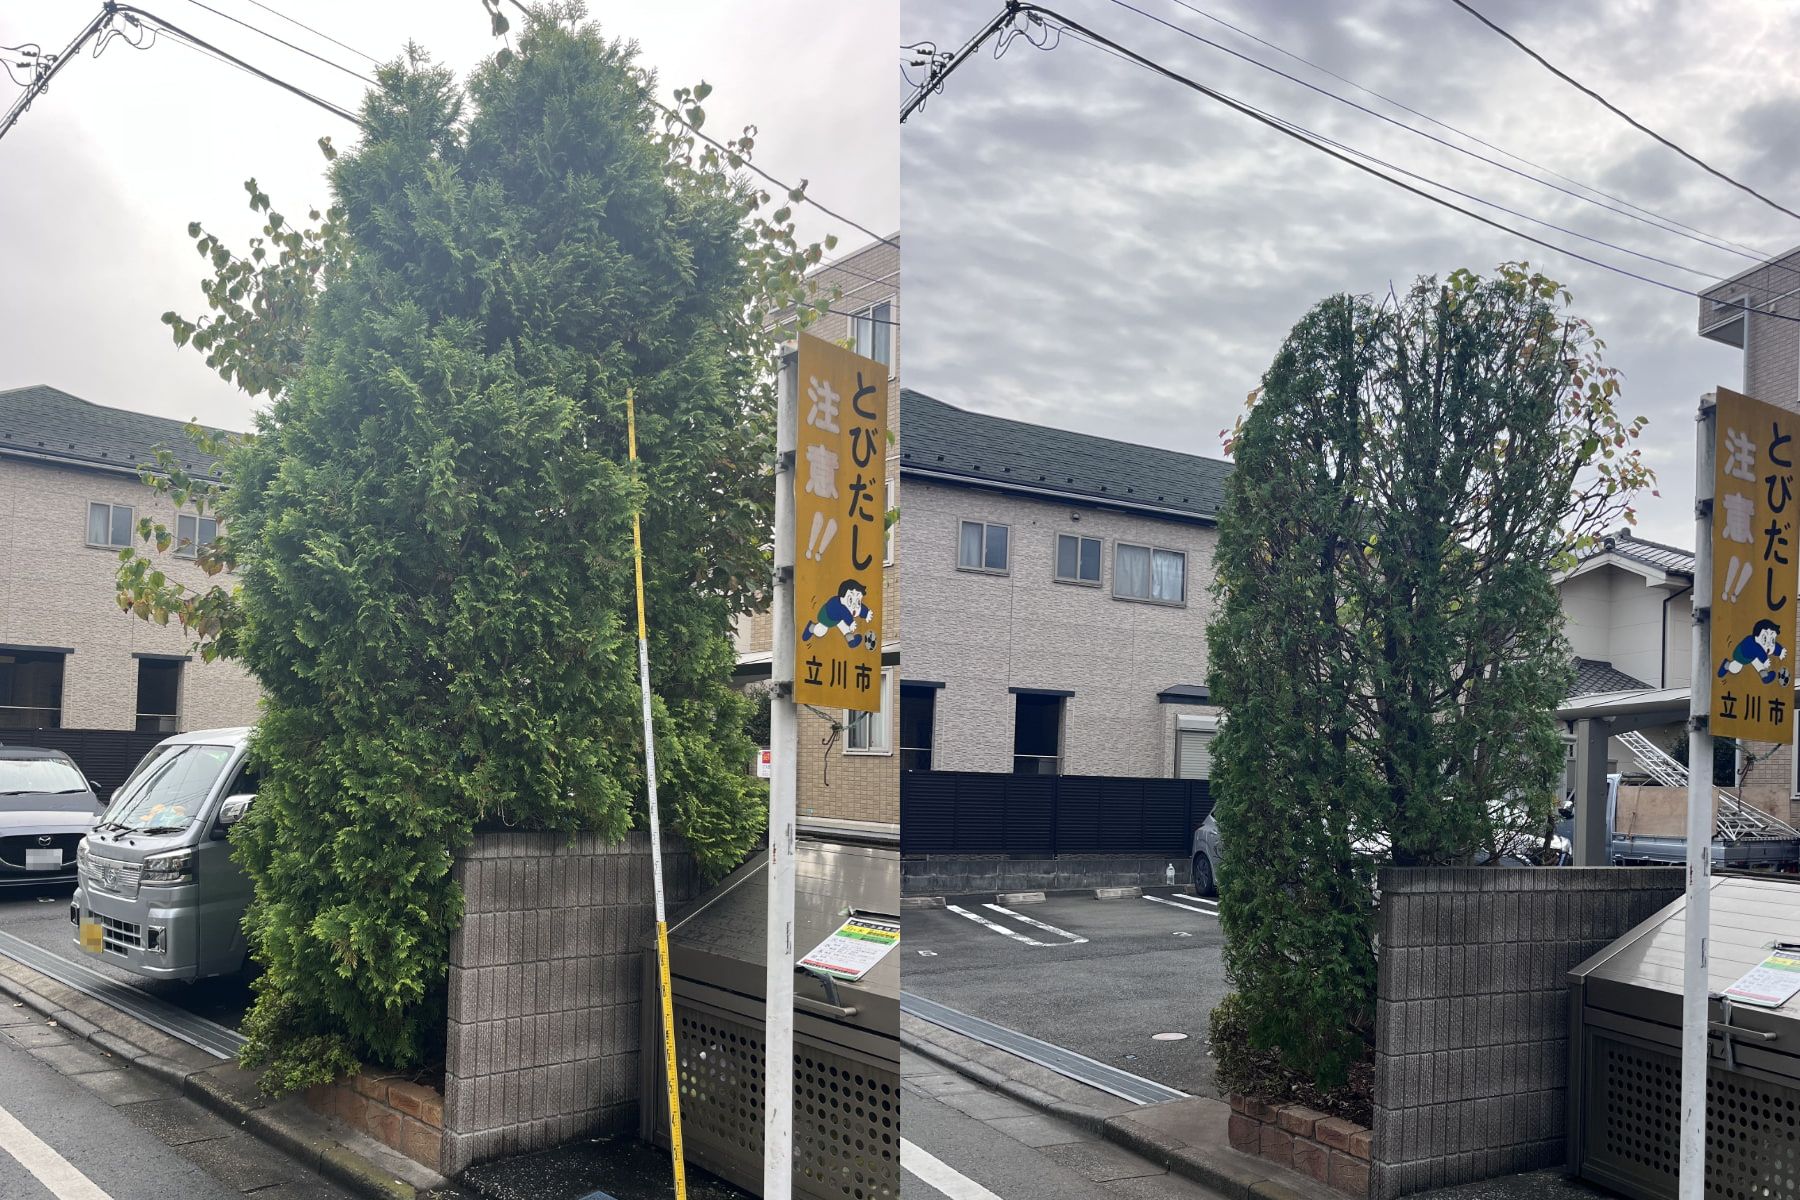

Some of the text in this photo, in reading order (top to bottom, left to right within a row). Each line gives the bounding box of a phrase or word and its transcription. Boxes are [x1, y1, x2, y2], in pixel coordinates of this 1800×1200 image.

[848, 371, 877, 571] とびだし
[1763, 422, 1794, 612] とびだし
[804, 655, 872, 693] 立川市
[1719, 691, 1786, 726] 立川市
